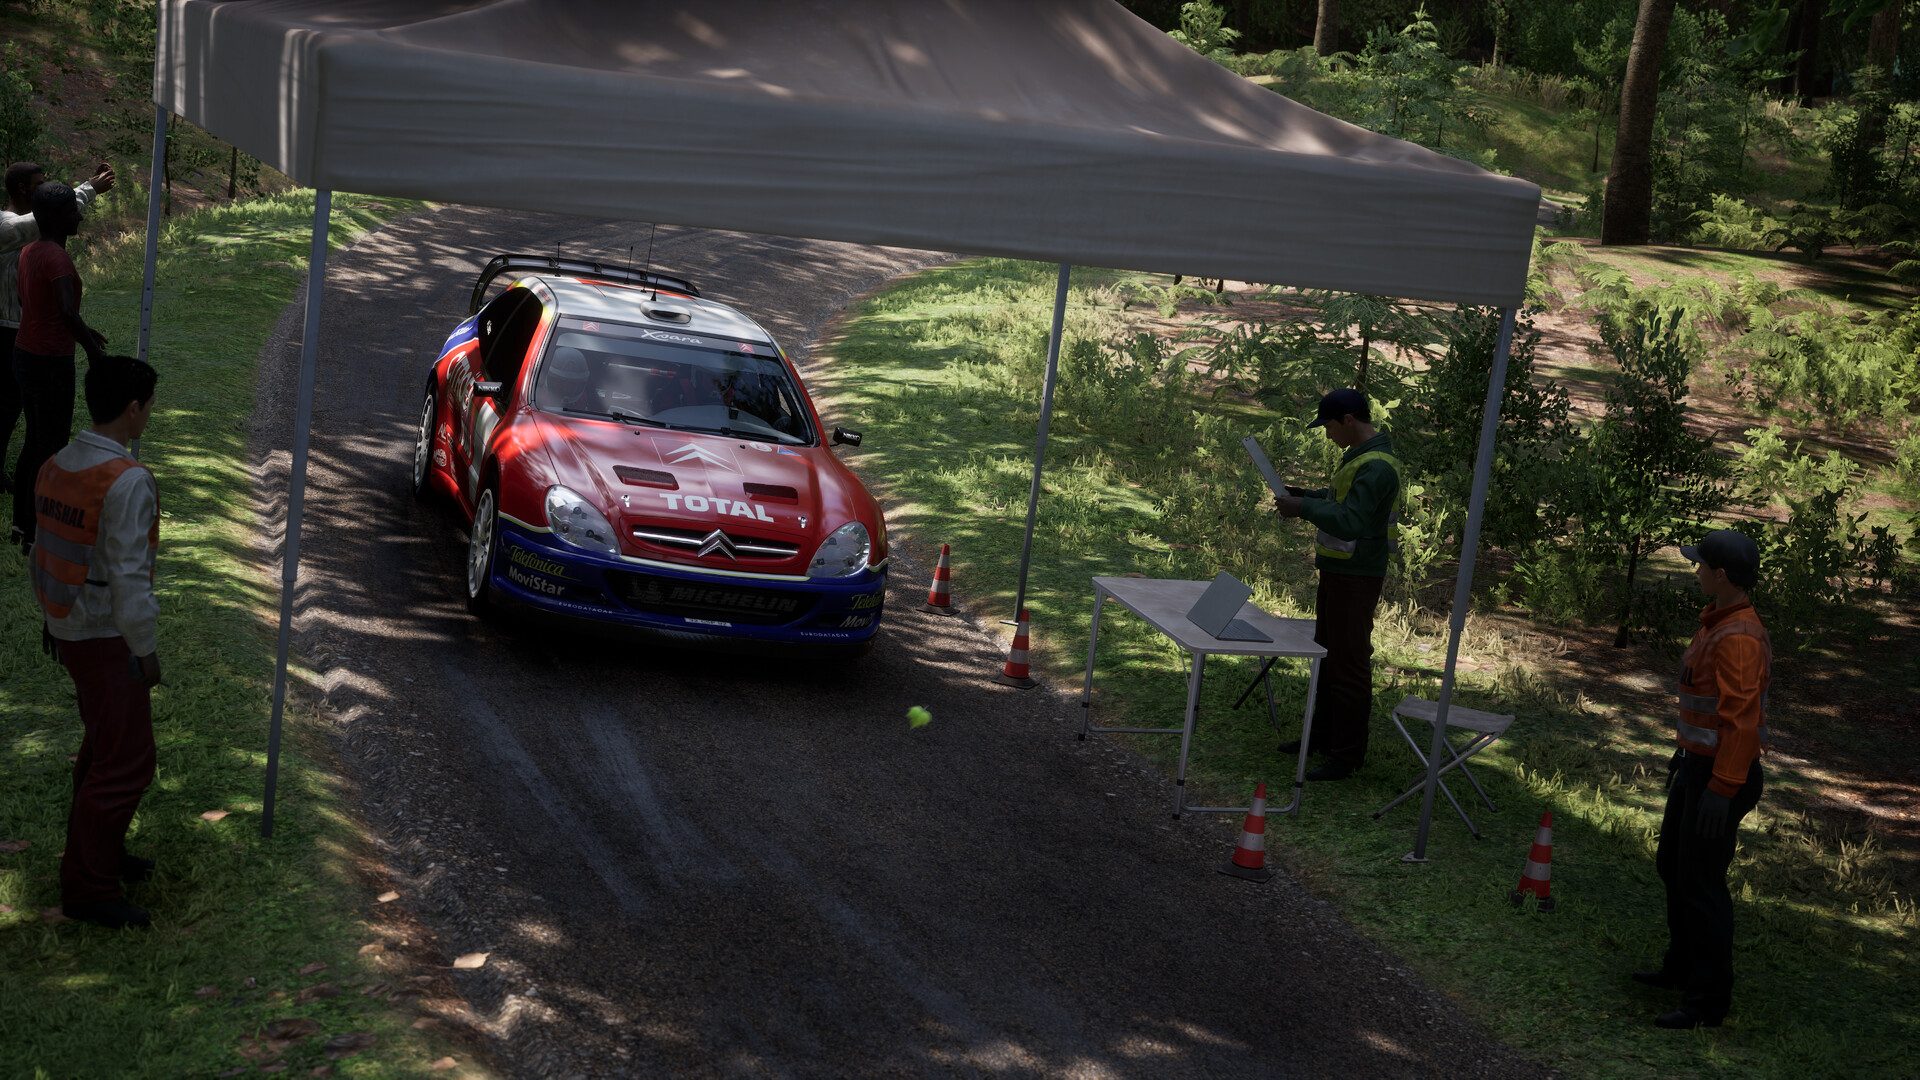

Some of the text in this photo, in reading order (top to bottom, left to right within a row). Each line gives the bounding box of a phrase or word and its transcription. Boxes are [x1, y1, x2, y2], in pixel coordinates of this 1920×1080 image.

[641, 329, 703, 345] Xsara
[36, 495, 86, 529] MARSHAL
[659, 493, 775, 523] TOTAL
[508, 565, 566, 597] MoviStar
[670, 585, 799, 613] MICHELIN
